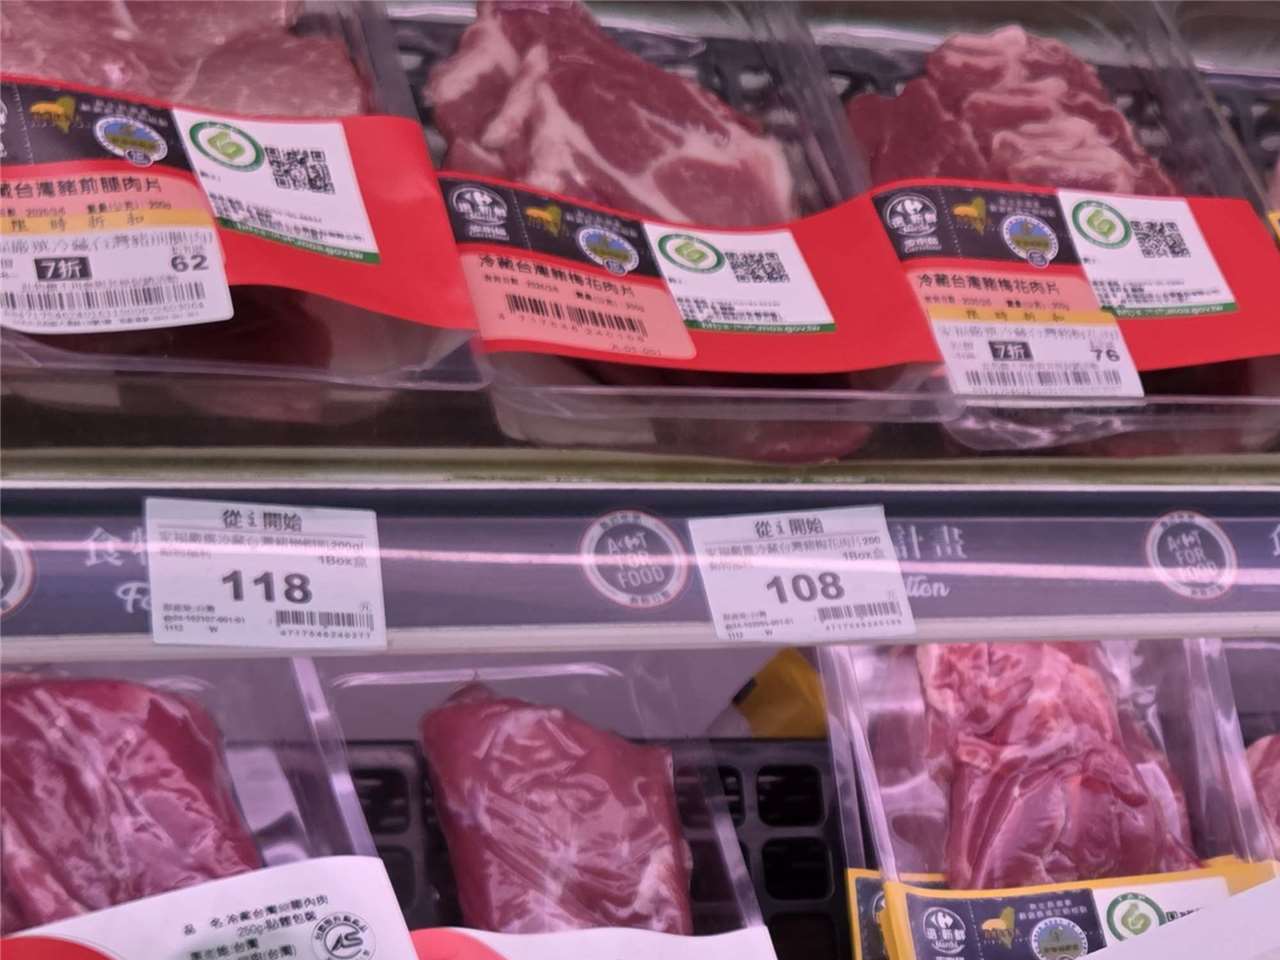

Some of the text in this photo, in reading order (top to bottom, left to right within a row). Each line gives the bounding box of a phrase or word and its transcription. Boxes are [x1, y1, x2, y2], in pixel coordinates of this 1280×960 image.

[39, 259, 83, 279] 7折
[171, 254, 209, 272] 62
[1090, 349, 1120, 362] 76
[222, 569, 313, 604] 118
[766, 571, 845, 604] 108
